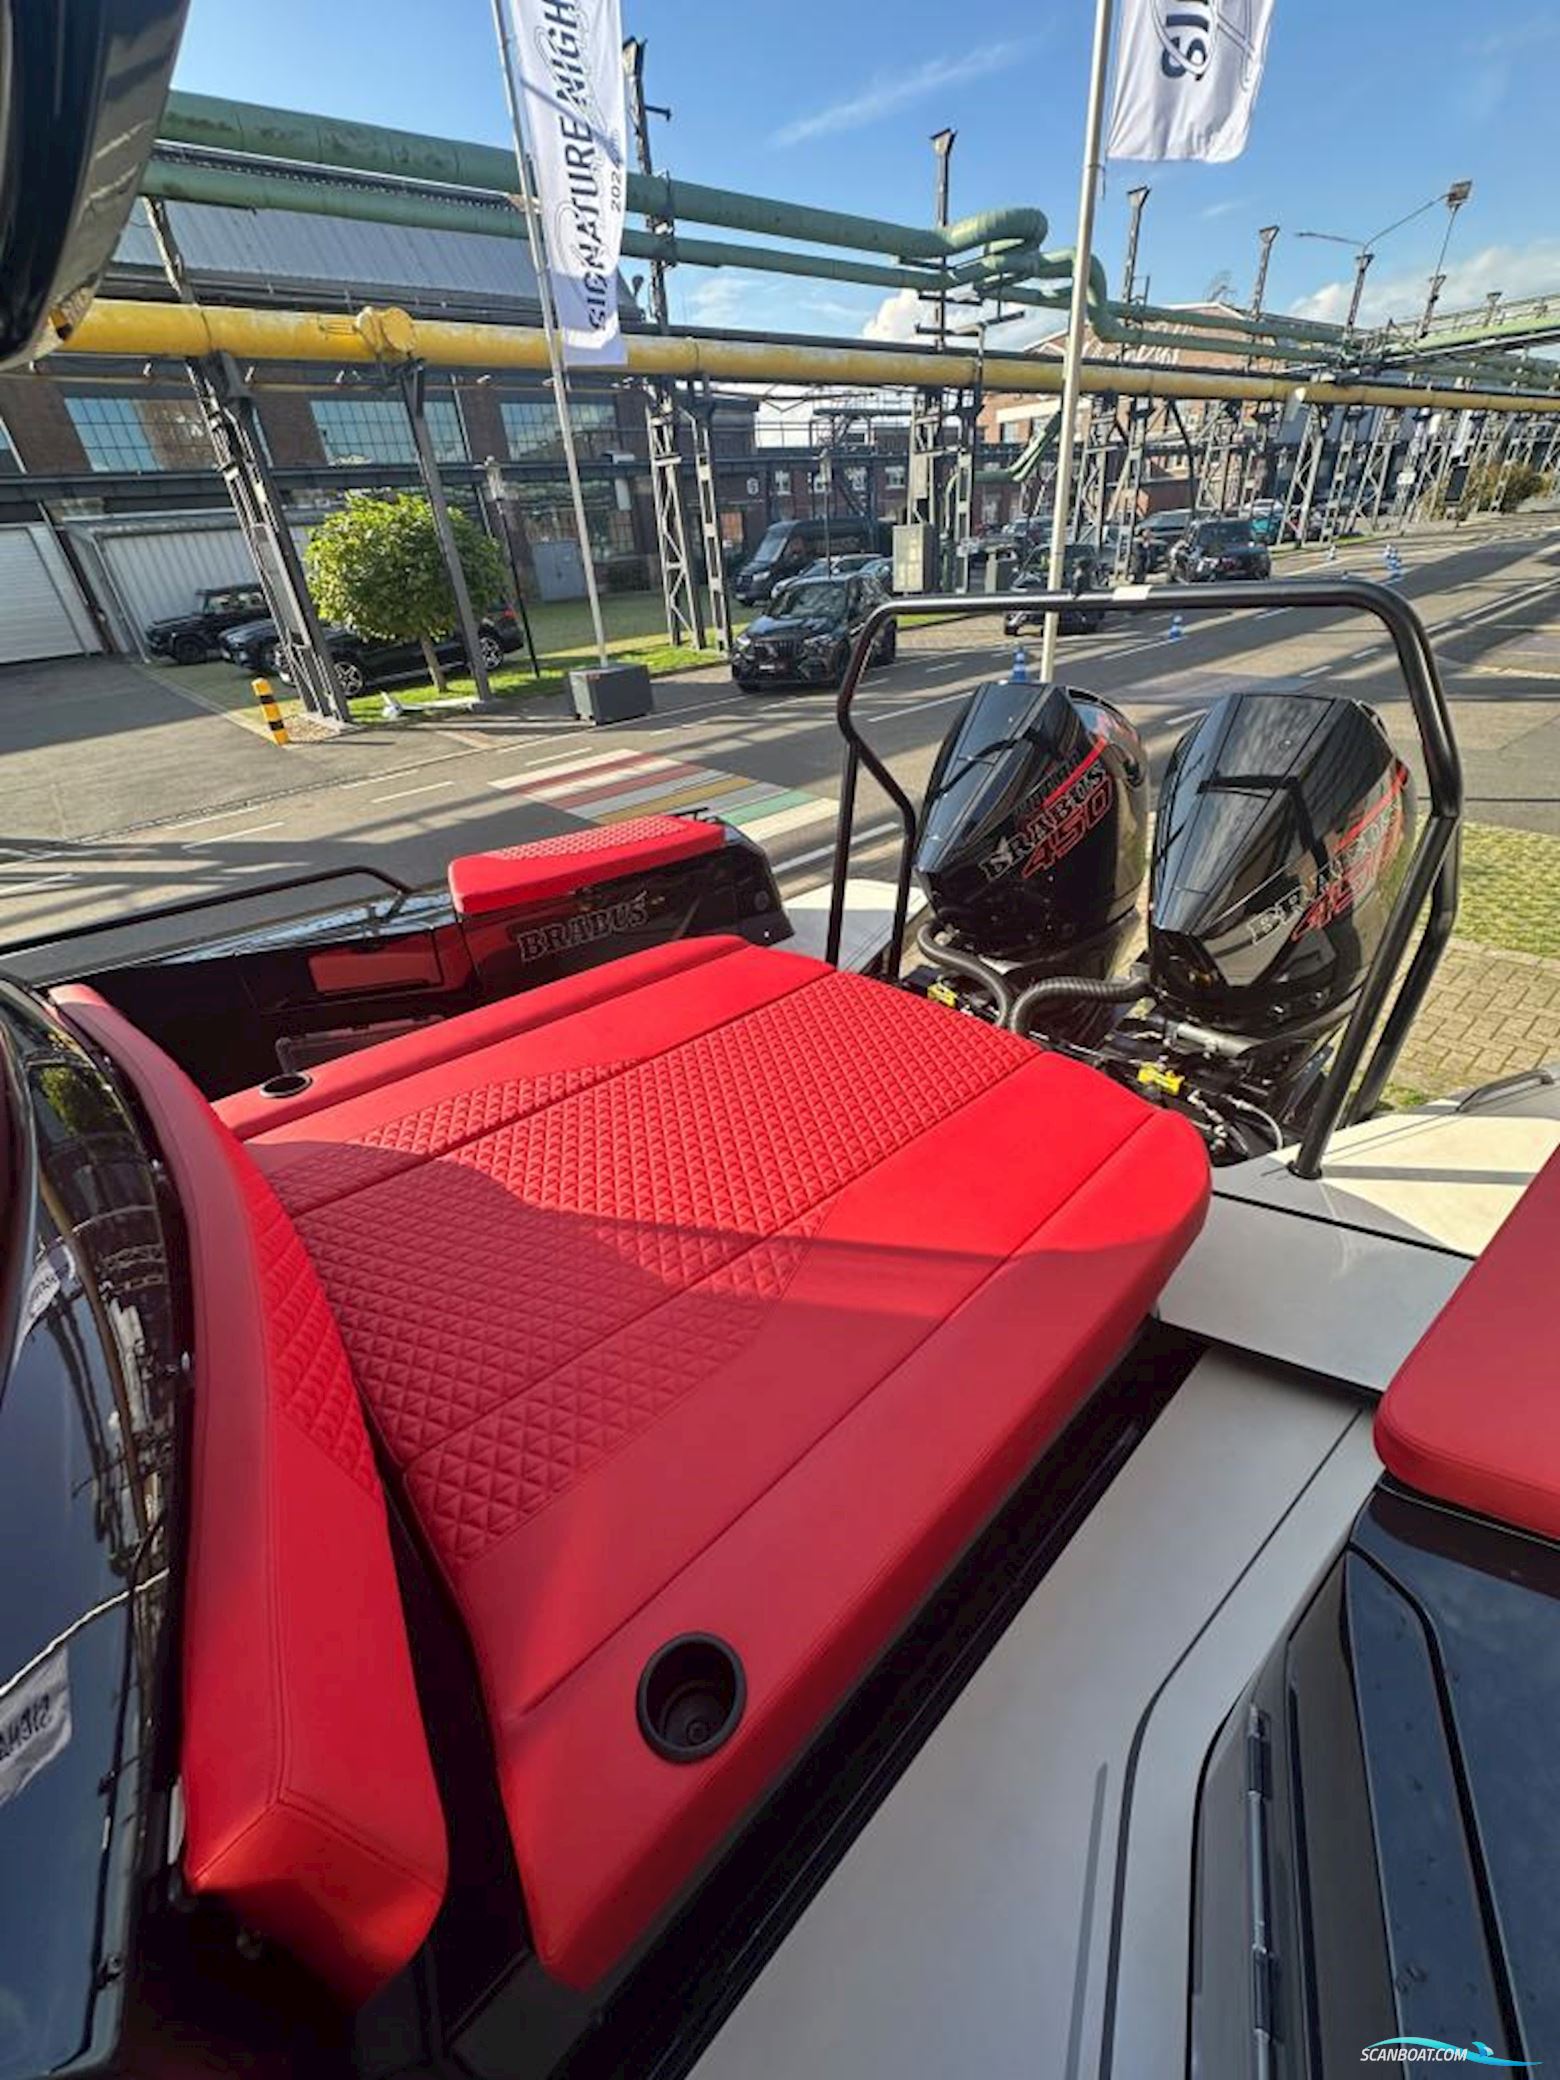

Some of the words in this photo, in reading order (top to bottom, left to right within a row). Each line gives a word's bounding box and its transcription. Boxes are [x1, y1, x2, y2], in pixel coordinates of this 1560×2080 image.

[559, 115, 608, 332] SIGNATURE
[978, 758, 1107, 882] BRABUS
[1021, 774, 1113, 880] 450
[517, 895, 648, 963] BRABUS
